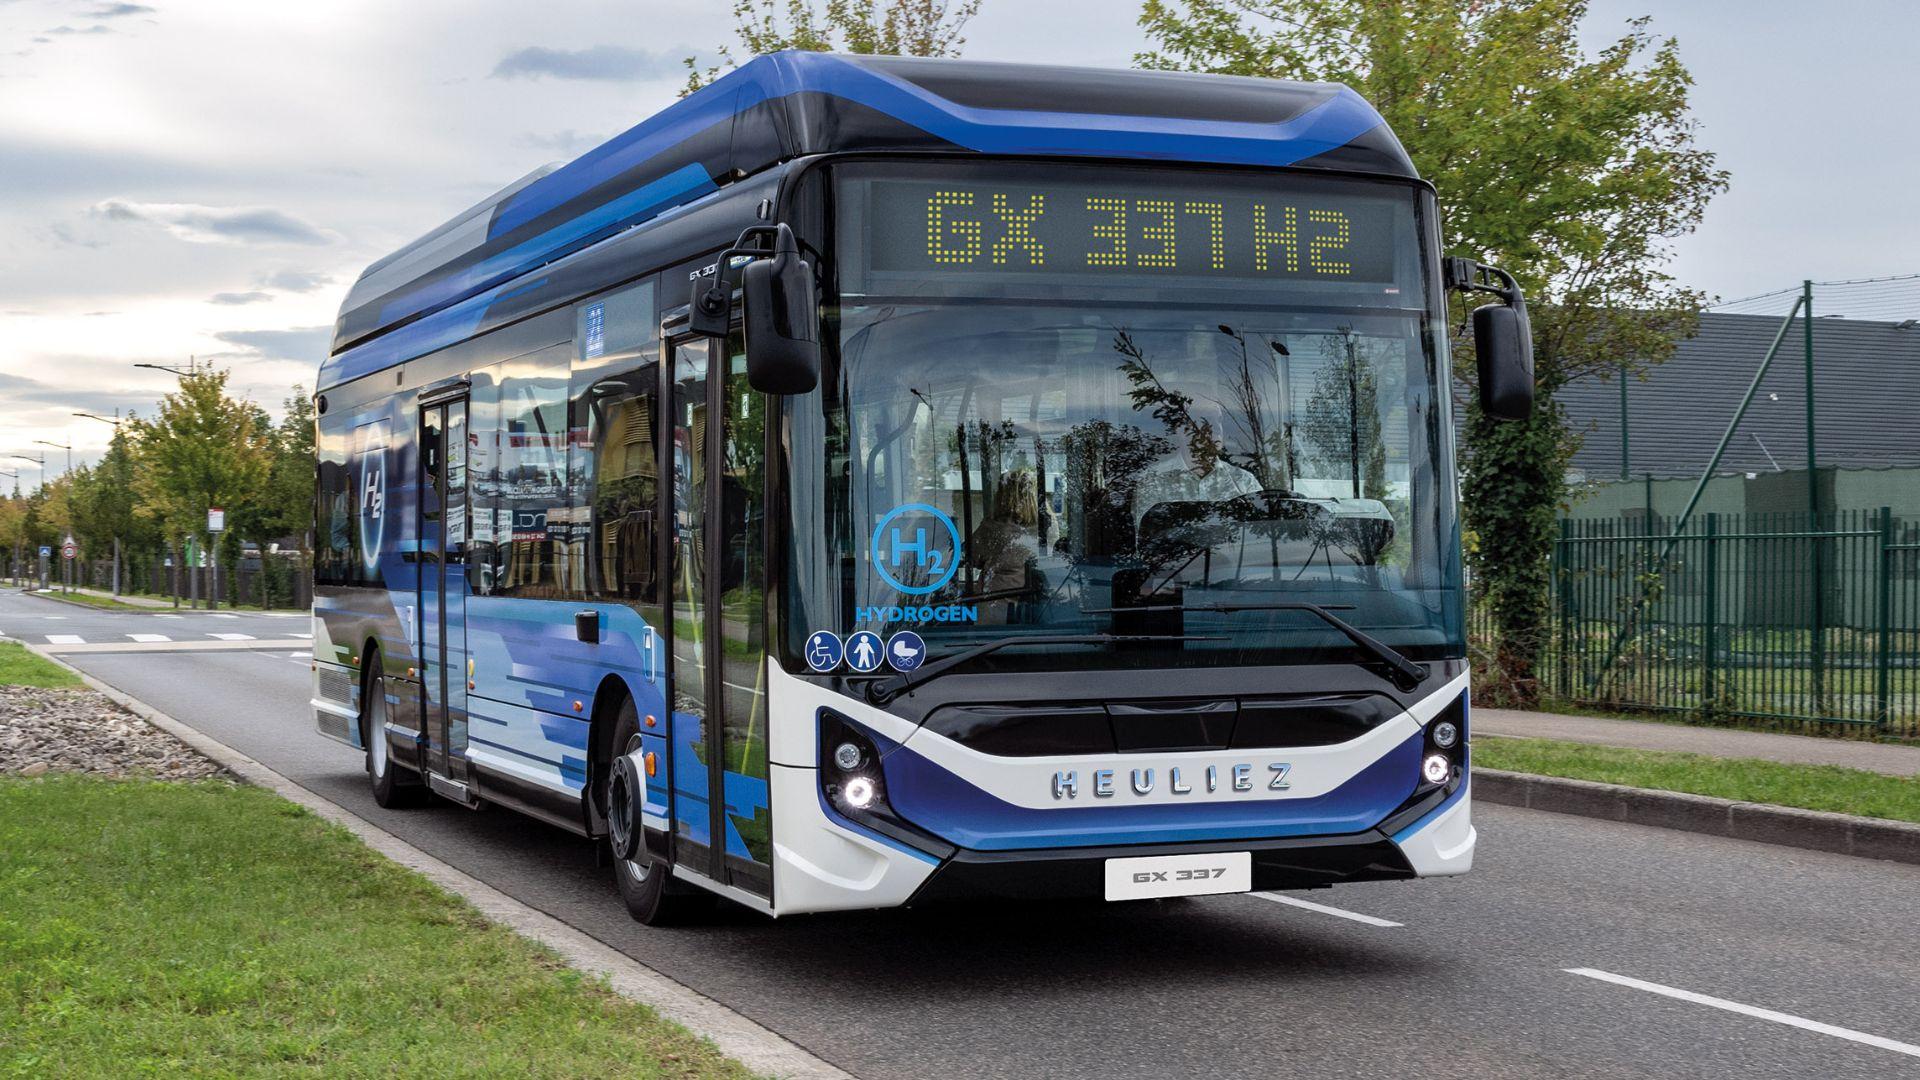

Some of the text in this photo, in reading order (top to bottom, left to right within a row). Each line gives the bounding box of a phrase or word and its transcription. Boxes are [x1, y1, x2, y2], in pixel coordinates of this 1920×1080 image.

[928, 191, 1352, 275] GX 337 H2
[364, 470, 382, 519] H2
[891, 527, 945, 574] H2
[856, 606, 978, 622] HYDROGEN
[1053, 762, 1292, 798] HEULIEZ
[1132, 867, 1227, 883] GX 337
